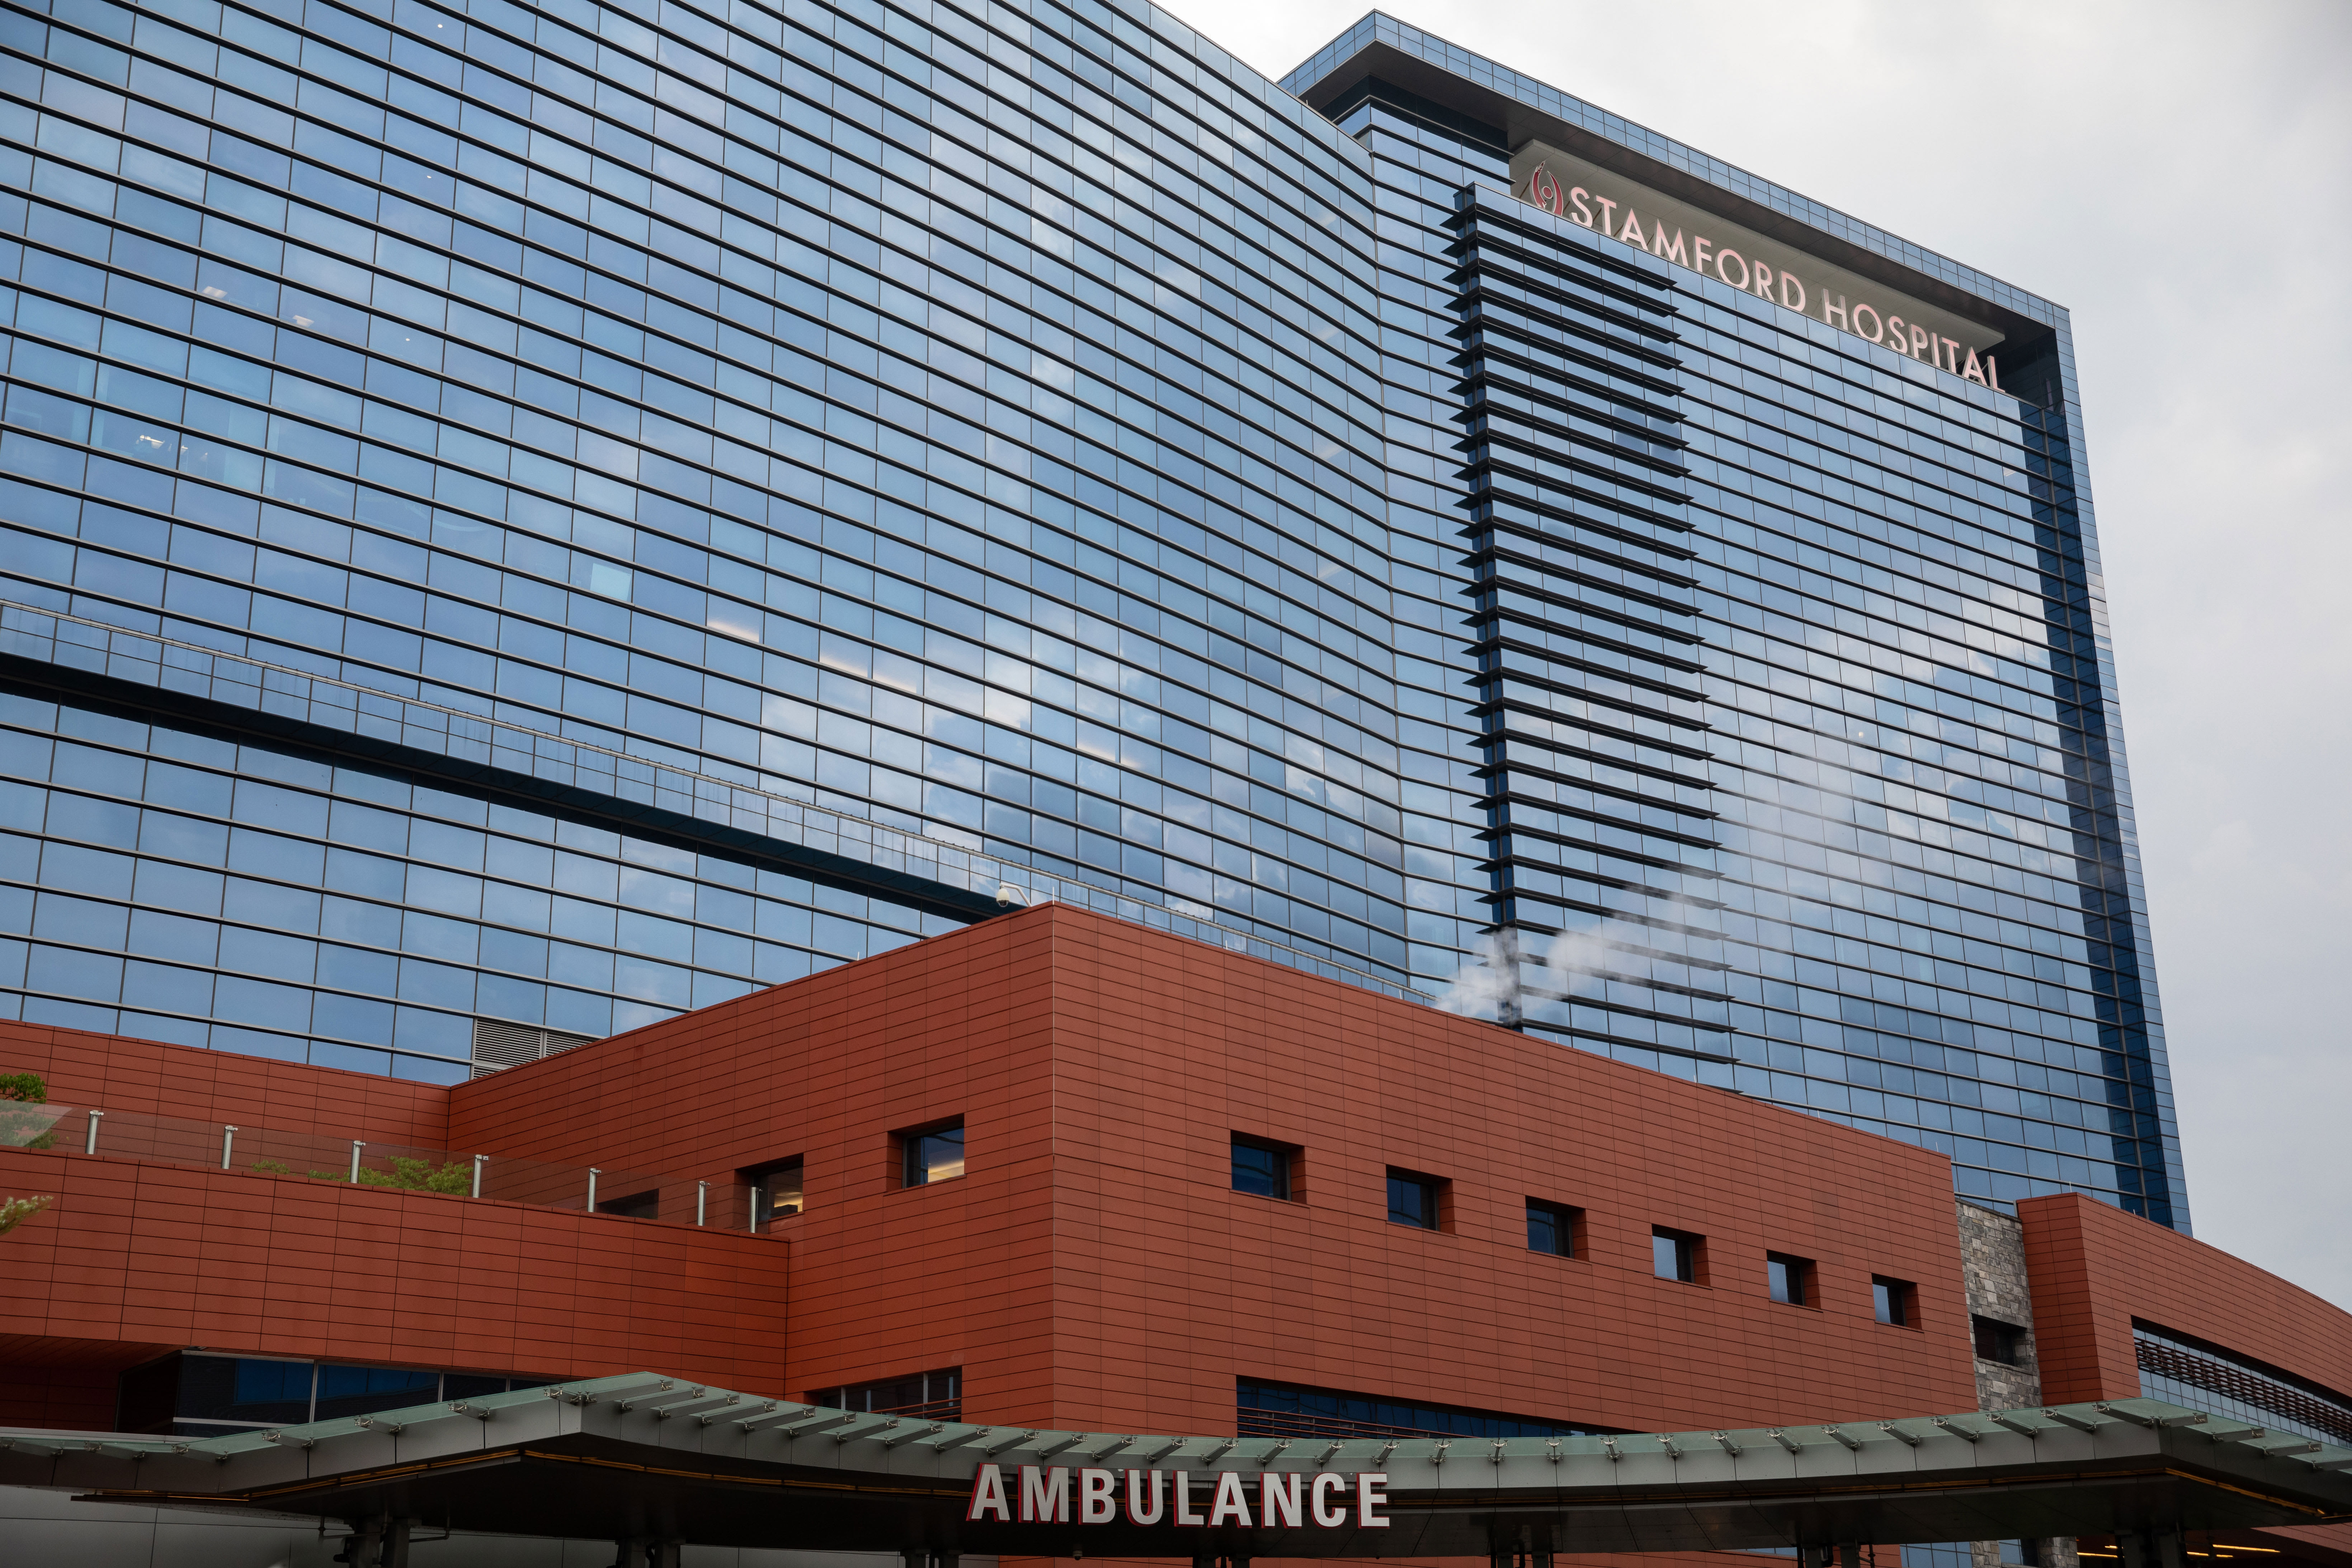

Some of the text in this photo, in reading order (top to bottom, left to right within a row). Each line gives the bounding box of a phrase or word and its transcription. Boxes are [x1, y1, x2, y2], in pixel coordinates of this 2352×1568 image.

[1569, 187, 2006, 393] STAMFORD HOSPITAL
[966, 1463, 1390, 1529] AMBULANCE
